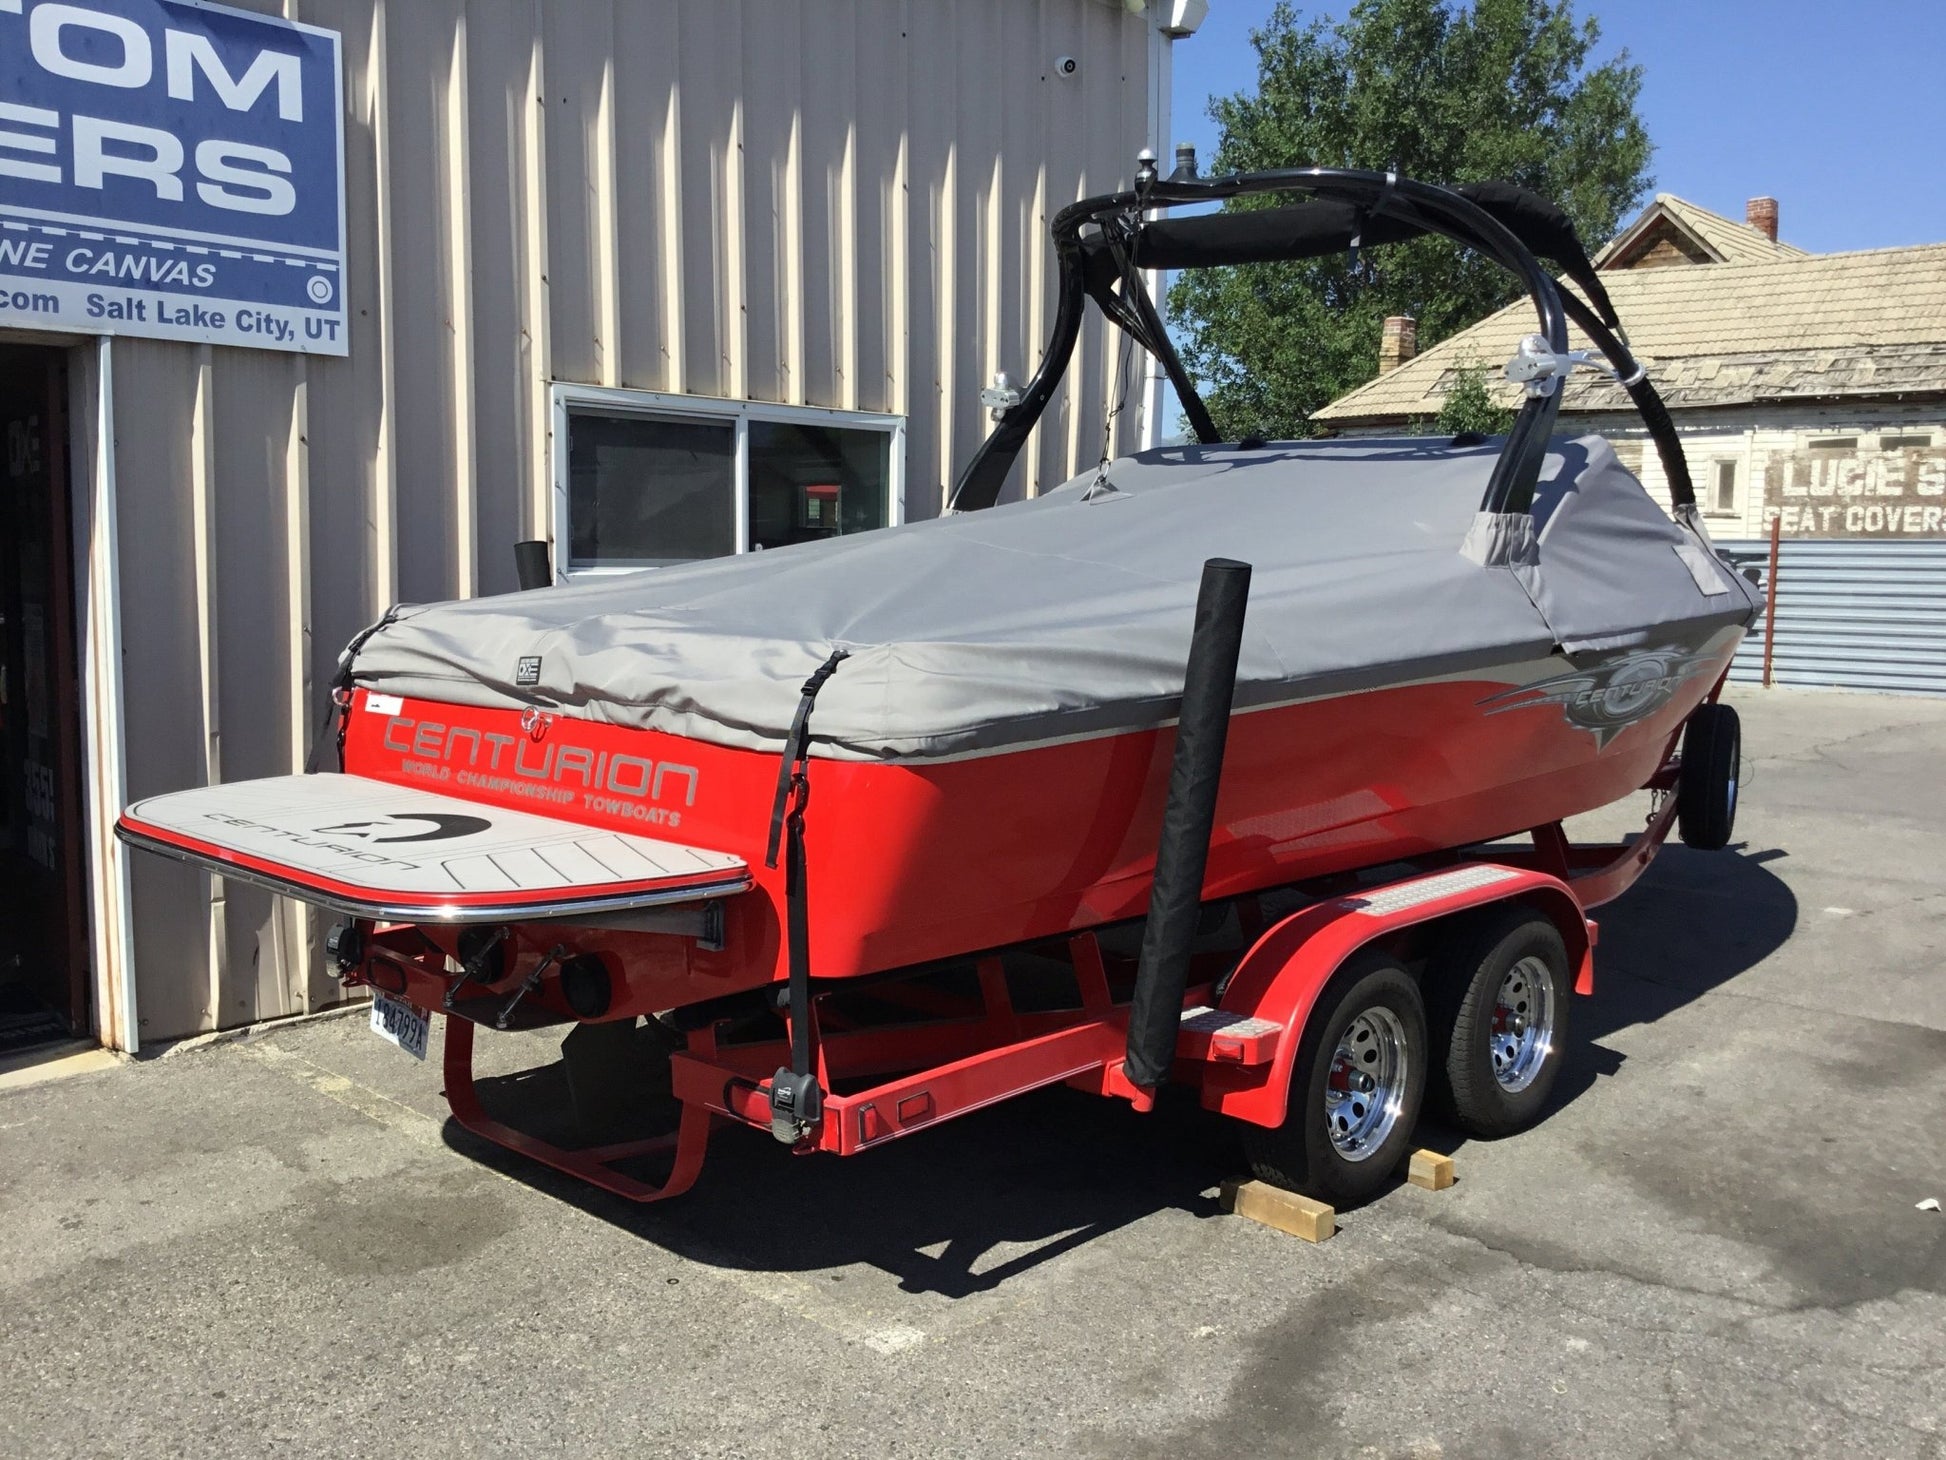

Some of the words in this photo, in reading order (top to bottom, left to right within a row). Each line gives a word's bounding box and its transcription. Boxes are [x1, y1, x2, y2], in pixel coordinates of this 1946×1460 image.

[0, 0, 303, 122] OM
[65, 247, 216, 288] CANVAS
[86, 293, 147, 322] Salt
[157, 300, 226, 329] Lake
[235, 311, 295, 342] City,
[305, 317, 341, 341] UT
[1763, 505, 1837, 533] SEAT
[384, 717, 699, 806] CENTURION
[402, 759, 451, 780] WORLD
[457, 770, 574, 804] CHAMPIONSHIP
[584, 794, 682, 828] TOWBOATS
[202, 813, 422, 871] CENTURION
